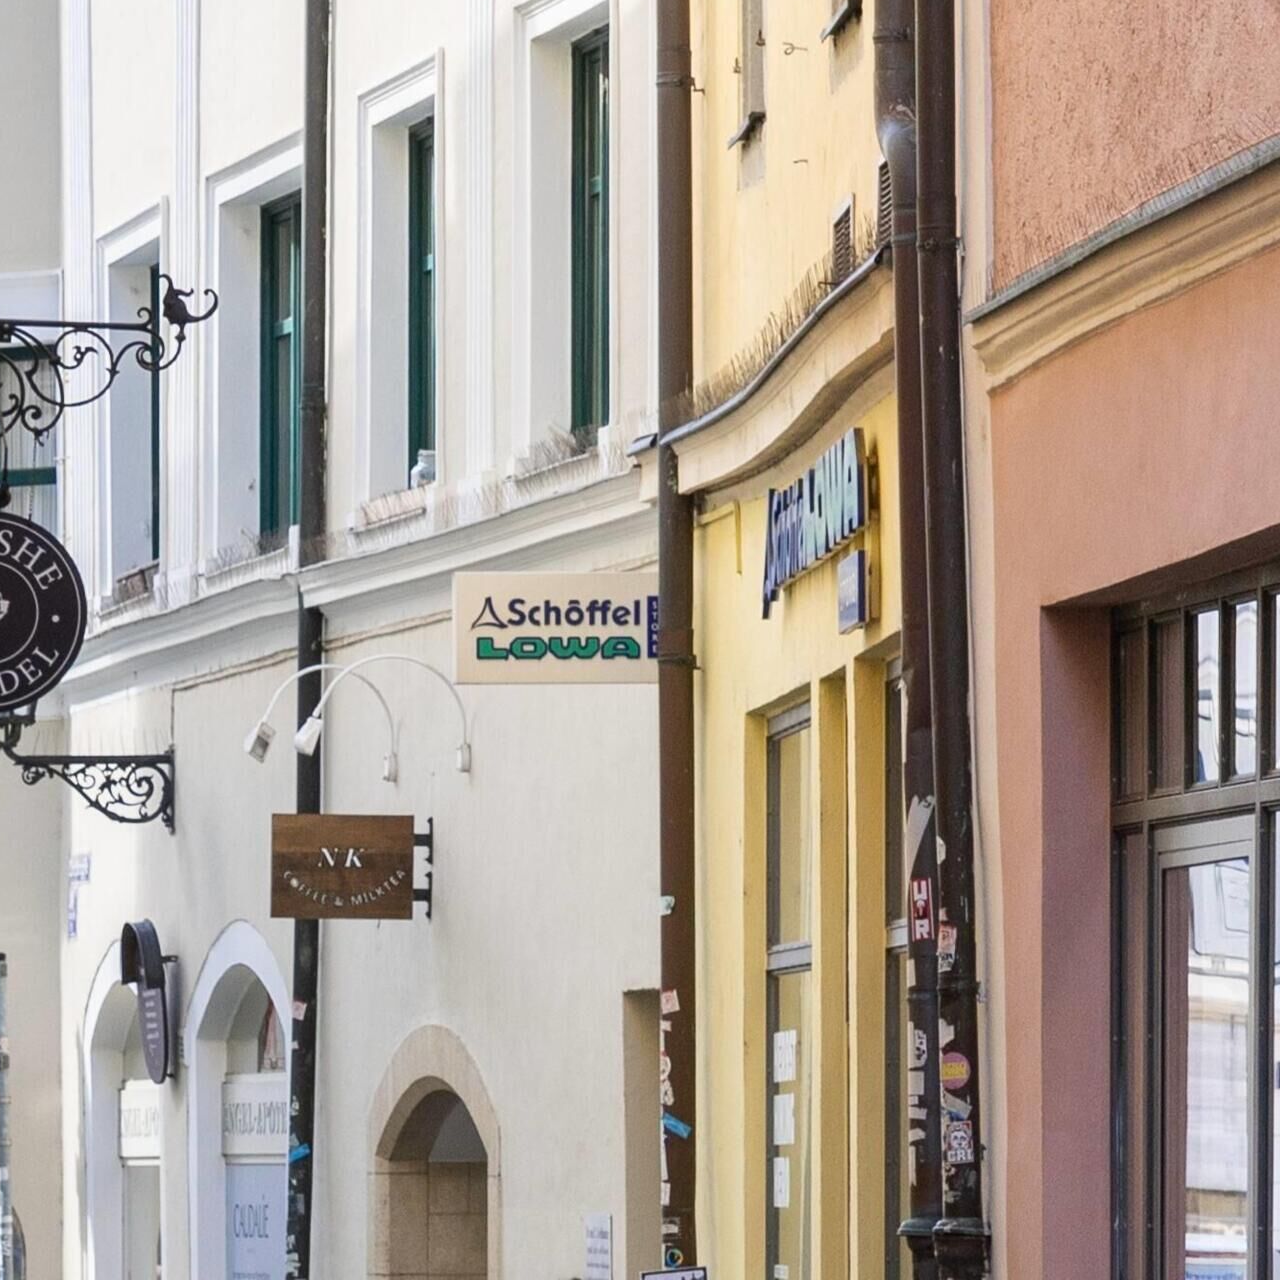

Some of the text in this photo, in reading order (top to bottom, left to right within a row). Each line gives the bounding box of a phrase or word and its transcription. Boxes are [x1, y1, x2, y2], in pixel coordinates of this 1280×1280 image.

[507, 598, 641, 627] Schöffel
[476, 636, 641, 660] LOWA
[282, 870, 328, 905] COFFEE
[350, 869, 407, 906] MILKTEA
